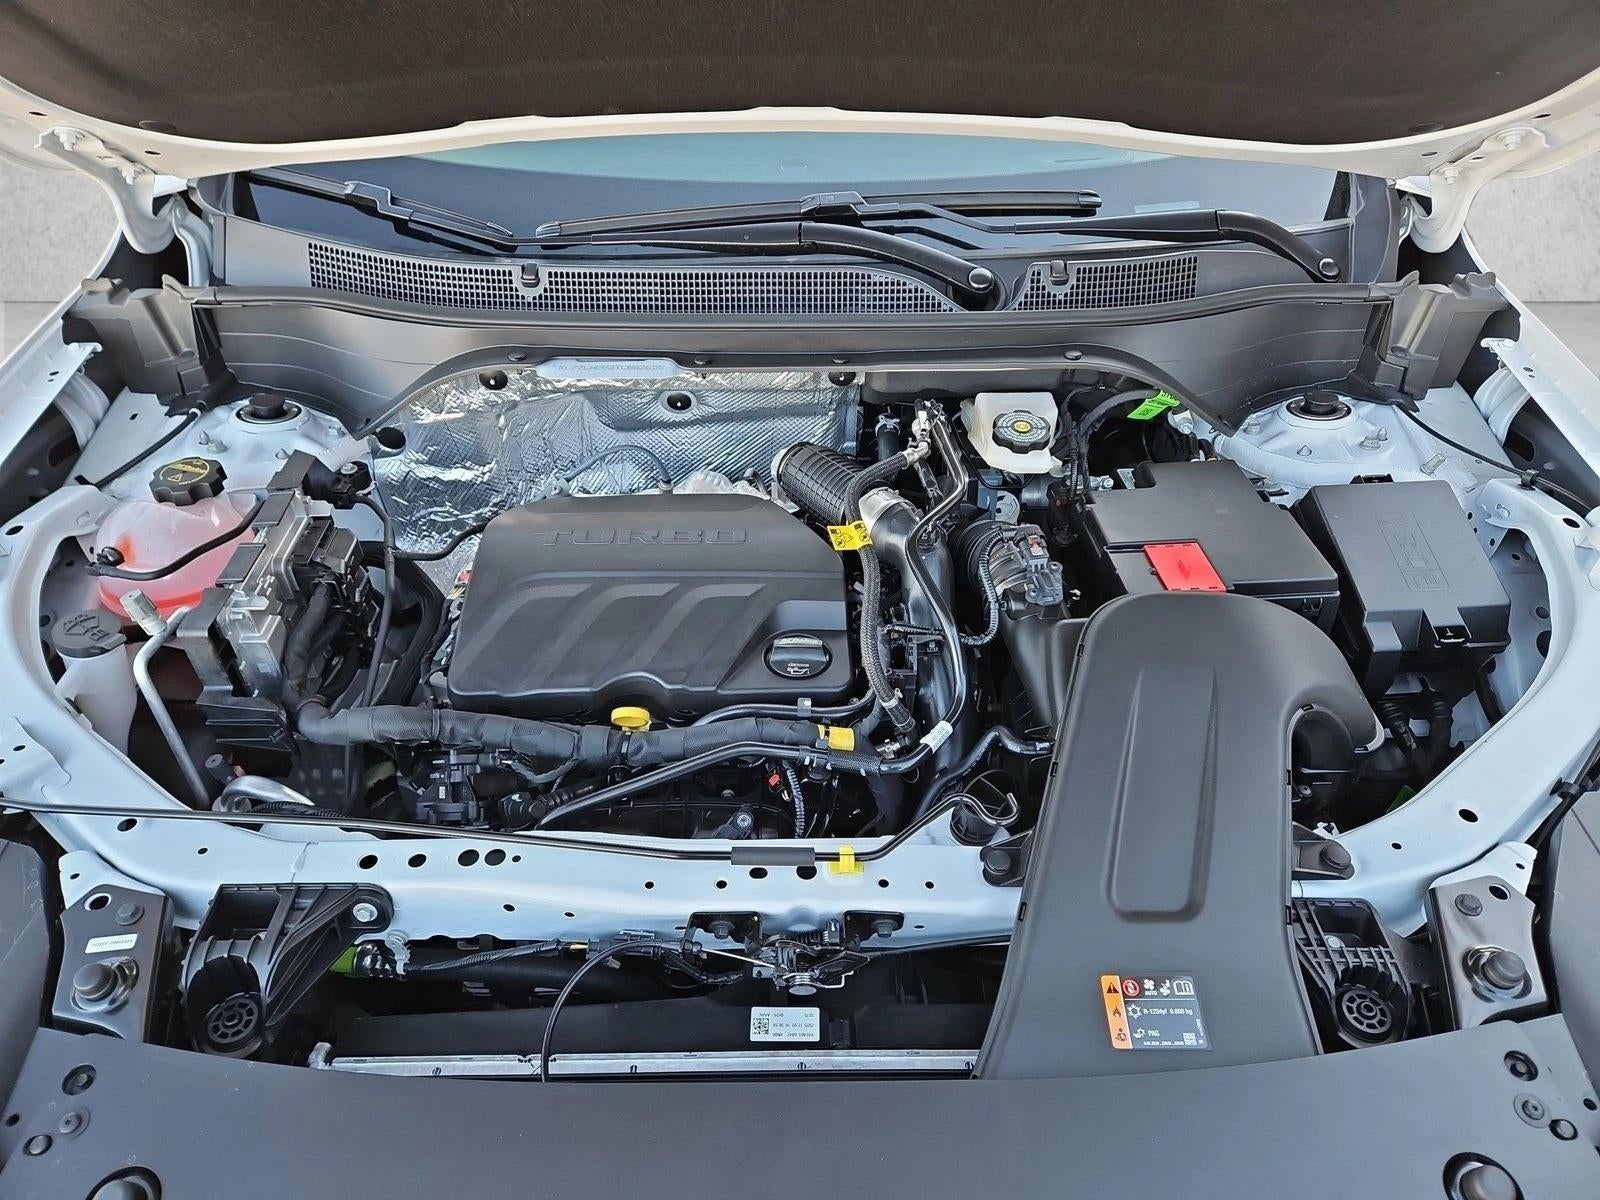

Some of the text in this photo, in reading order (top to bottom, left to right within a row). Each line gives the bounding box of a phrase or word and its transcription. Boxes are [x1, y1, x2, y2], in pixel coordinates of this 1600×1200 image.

[530, 527, 748, 547] TURBO
[1143, 1008, 1167, 1016] R-1234yf
[1185, 1008, 1193, 1016] kg
[1147, 1029, 1160, 1037] PAG
